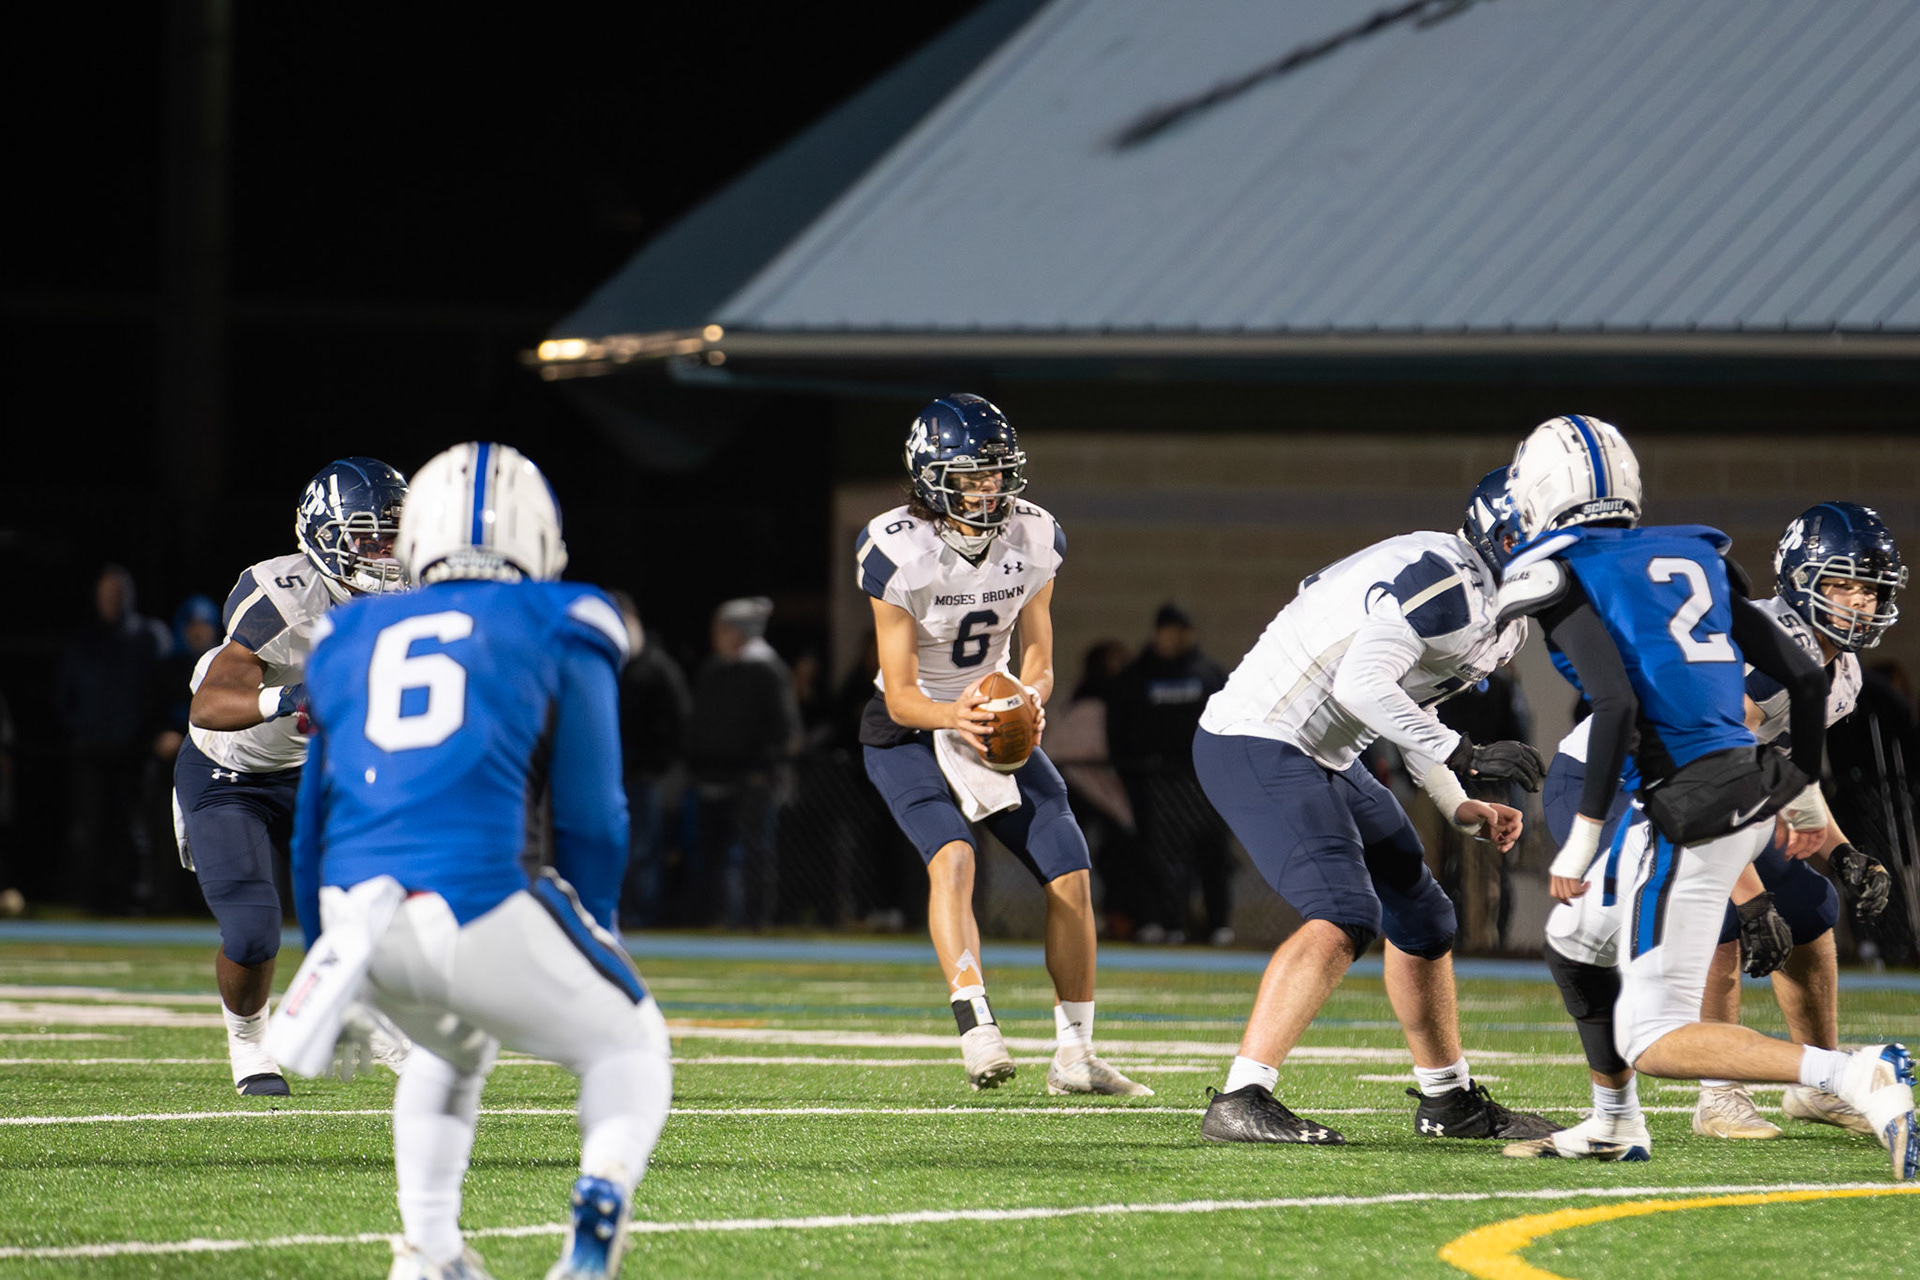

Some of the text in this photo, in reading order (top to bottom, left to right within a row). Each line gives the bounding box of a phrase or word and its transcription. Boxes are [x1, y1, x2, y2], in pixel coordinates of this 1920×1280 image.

[1583, 500, 1625, 515] schutt
[885, 520, 915, 534] 6
[274, 575, 306, 588] 5
[1455, 558, 1485, 590] 71
[935, 585, 1025, 606] MOSES BROWN
[1646, 556, 1737, 663] 2
[951, 609, 999, 668] 6
[364, 610, 473, 753] 6
